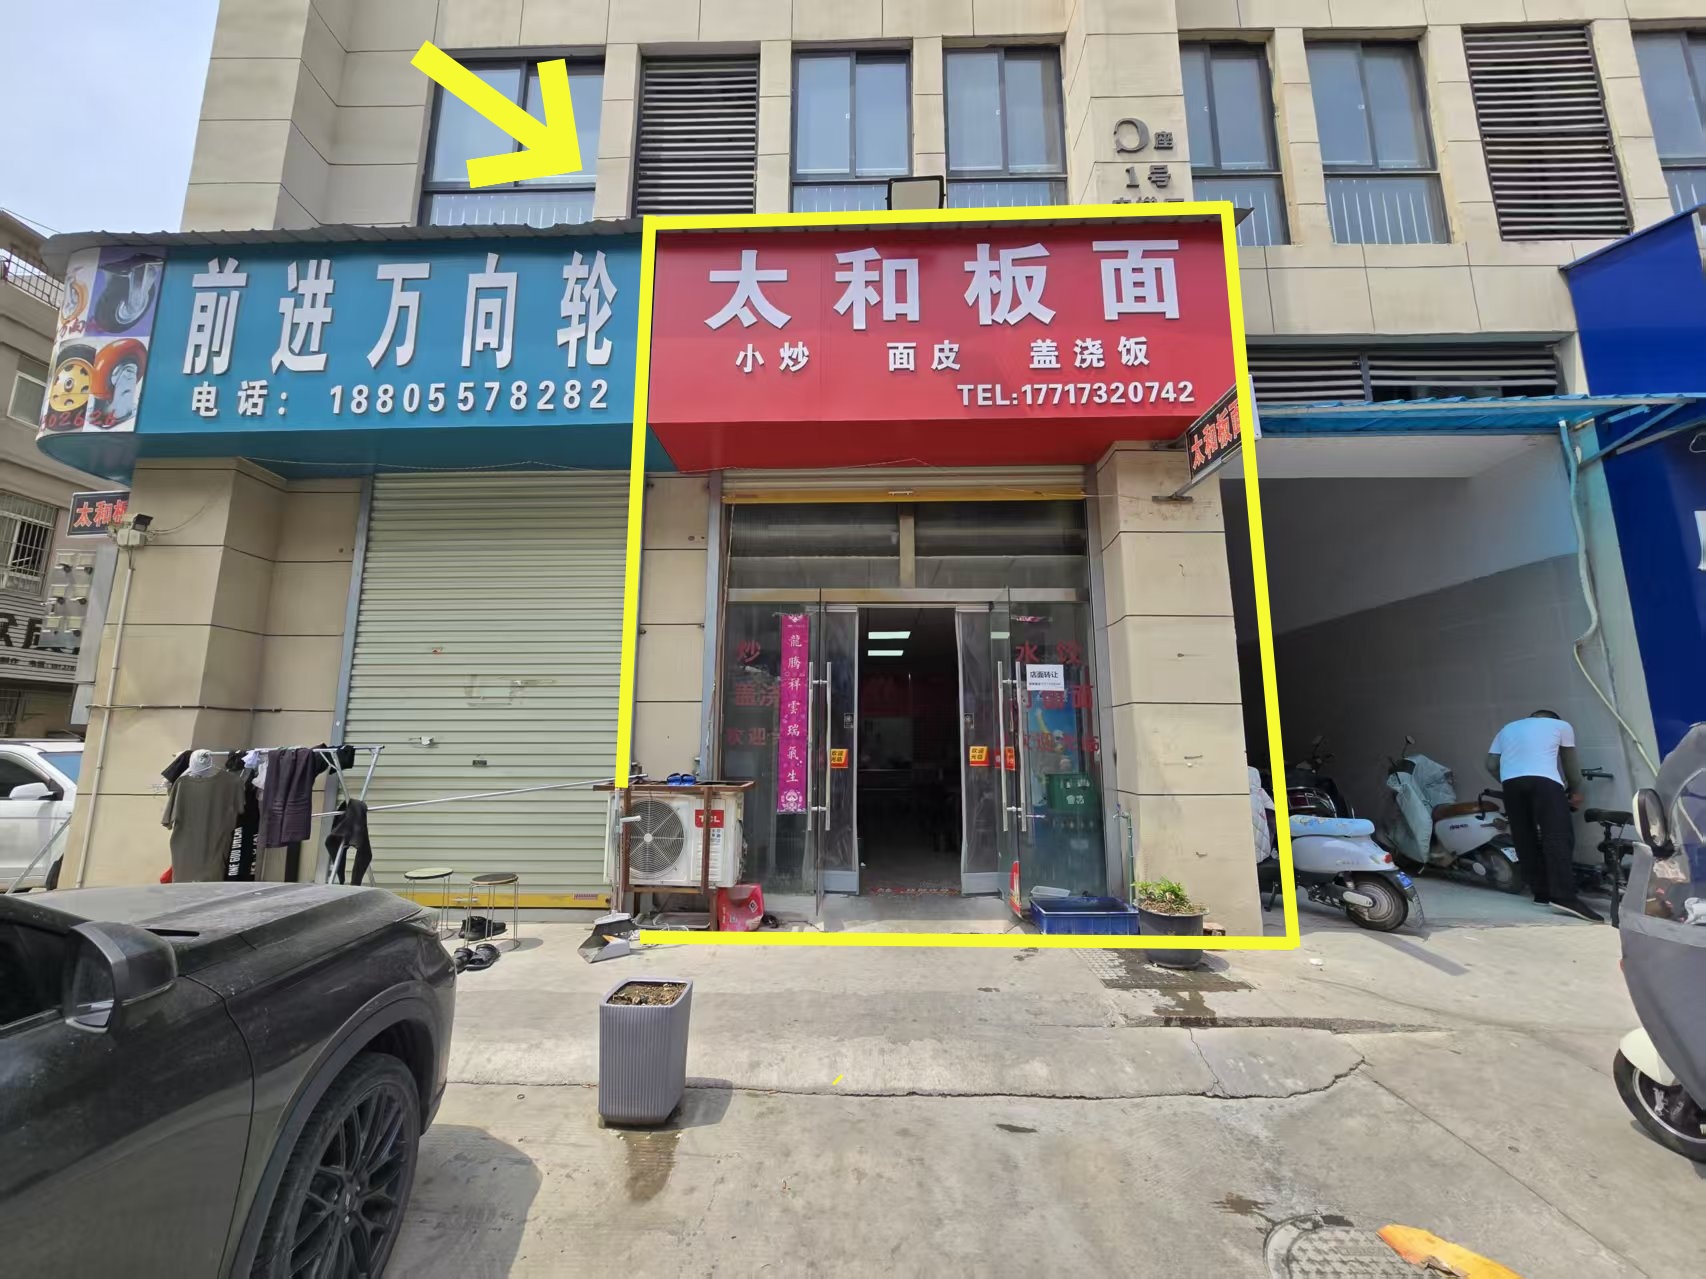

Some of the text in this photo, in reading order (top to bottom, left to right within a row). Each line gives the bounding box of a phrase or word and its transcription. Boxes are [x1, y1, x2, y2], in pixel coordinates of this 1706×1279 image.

[1125, 165, 1171, 188] 1号
[704, 239, 1181, 332] 太和板面
[183, 250, 618, 375] 前进万向轮
[735, 336, 1150, 374] 小炒 面皮 盖浇饭
[329, 379, 610, 415] 18805578282
